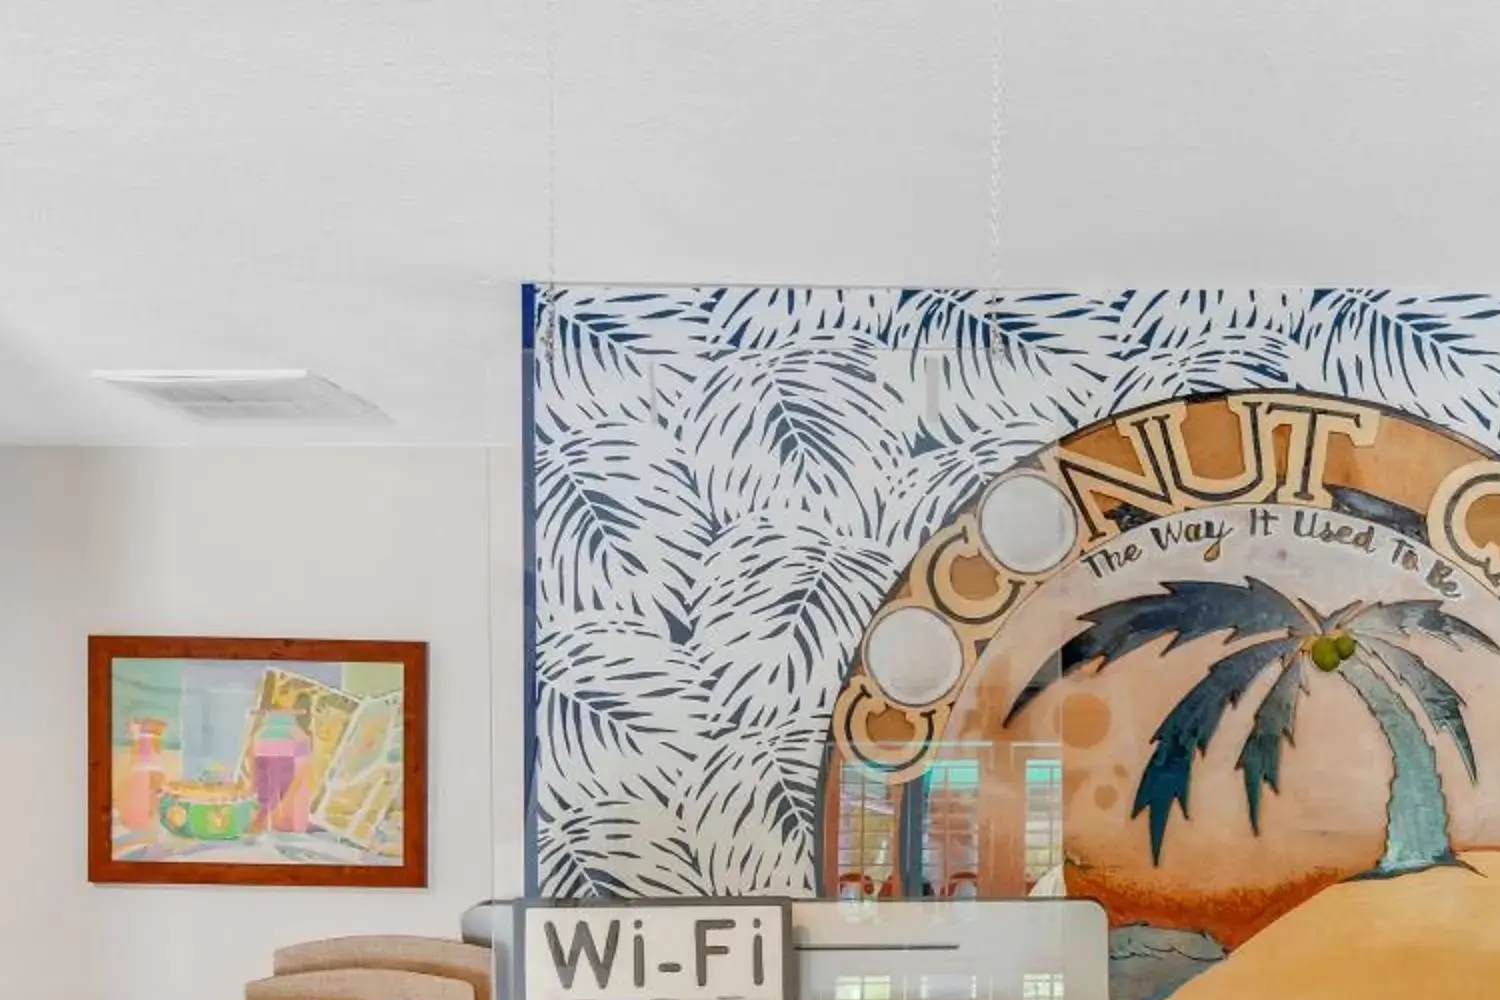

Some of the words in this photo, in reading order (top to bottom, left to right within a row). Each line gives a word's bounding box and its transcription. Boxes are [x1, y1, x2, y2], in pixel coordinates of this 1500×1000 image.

[1081, 544, 1142, 578] The
[1150, 518, 1233, 562] Way
[1249, 508, 1279, 536] It
[1293, 509, 1376, 553] Used
[1391, 537, 1419, 571] To
[1425, 559, 1461, 598] Be
[544, 918, 764, 989] Wi-Fi
